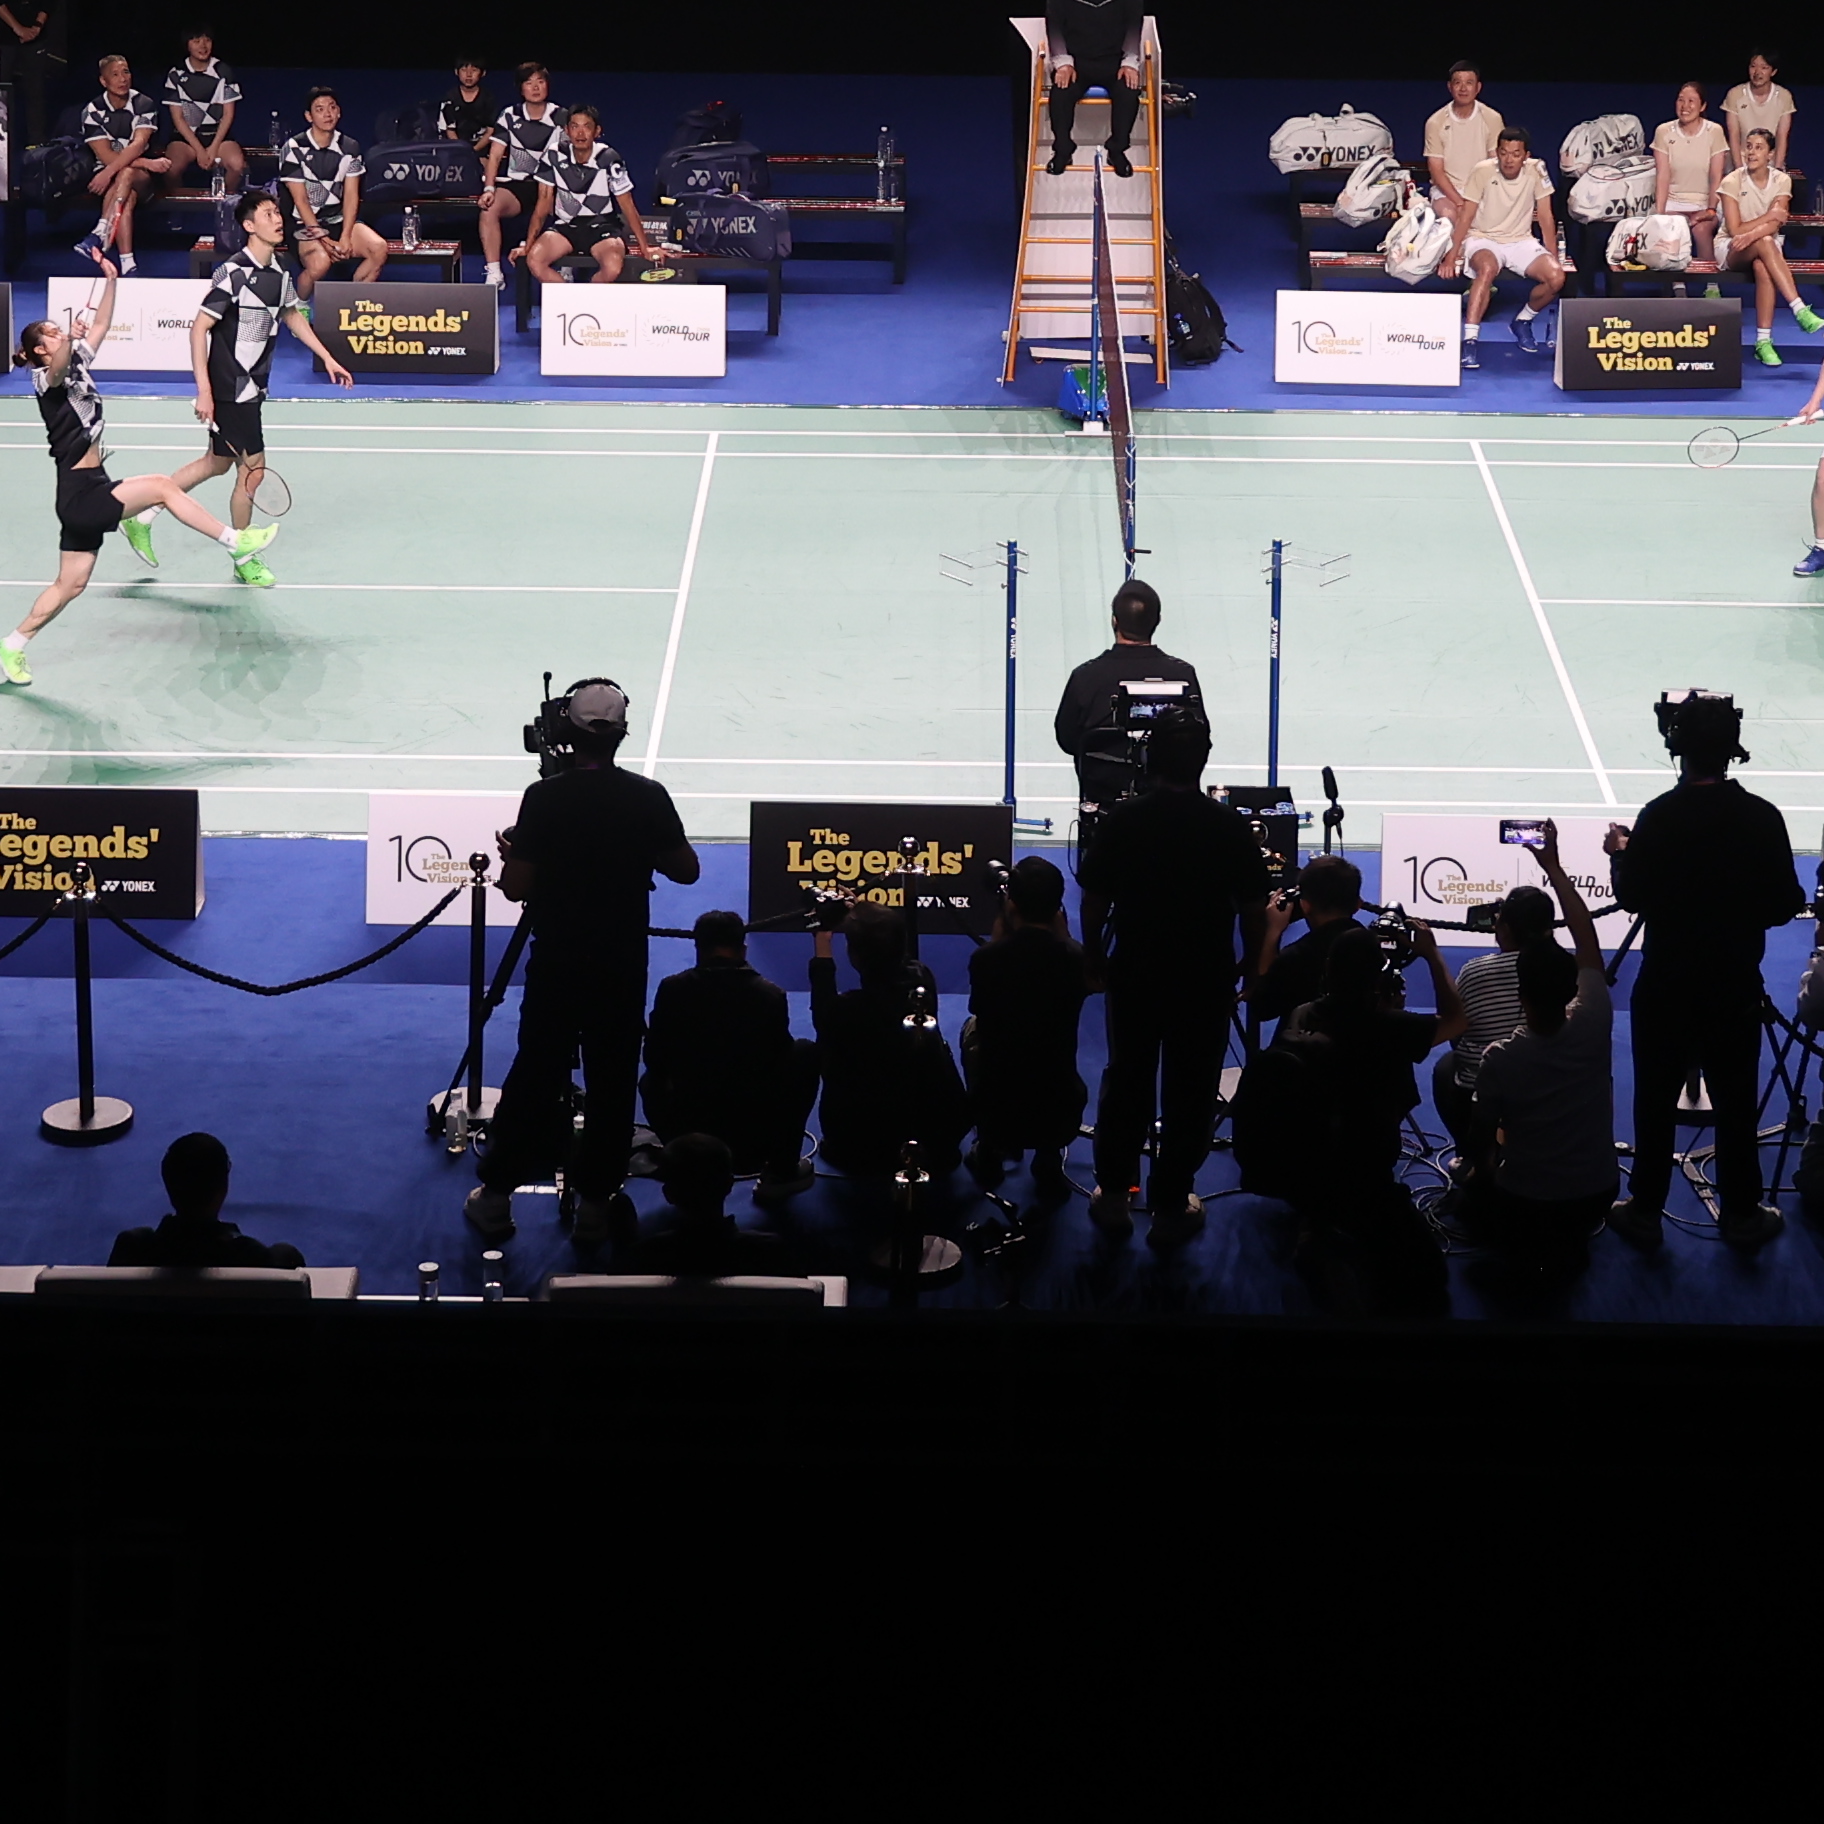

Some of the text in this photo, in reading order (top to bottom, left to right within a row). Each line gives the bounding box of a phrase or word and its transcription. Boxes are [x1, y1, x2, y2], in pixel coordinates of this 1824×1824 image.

[1326, 144, 1376, 162] YONEX
[415, 164, 464, 182] YOEX
[355, 299, 384, 313] The
[339, 308, 470, 337] Legends'
[652, 325, 690, 335] WORLD
[1603, 316, 1632, 329] The
[683, 332, 710, 341] TOUR
[1387, 334, 1425, 344] WORLD
[1587, 324, 1717, 354] Legends'
[347, 335, 466, 356] Vision YONEX
[1418, 341, 1446, 350] TOUR
[1596, 352, 1716, 371] Vision YONEX
[809, 828, 850, 846] The
[389, 835, 452, 883] 10
[122, 880, 156, 893] YONEX
[1403, 856, 1468, 904] 10
[1437, 879, 1509, 894] Legends'
[1442, 894, 1484, 905] Vision
